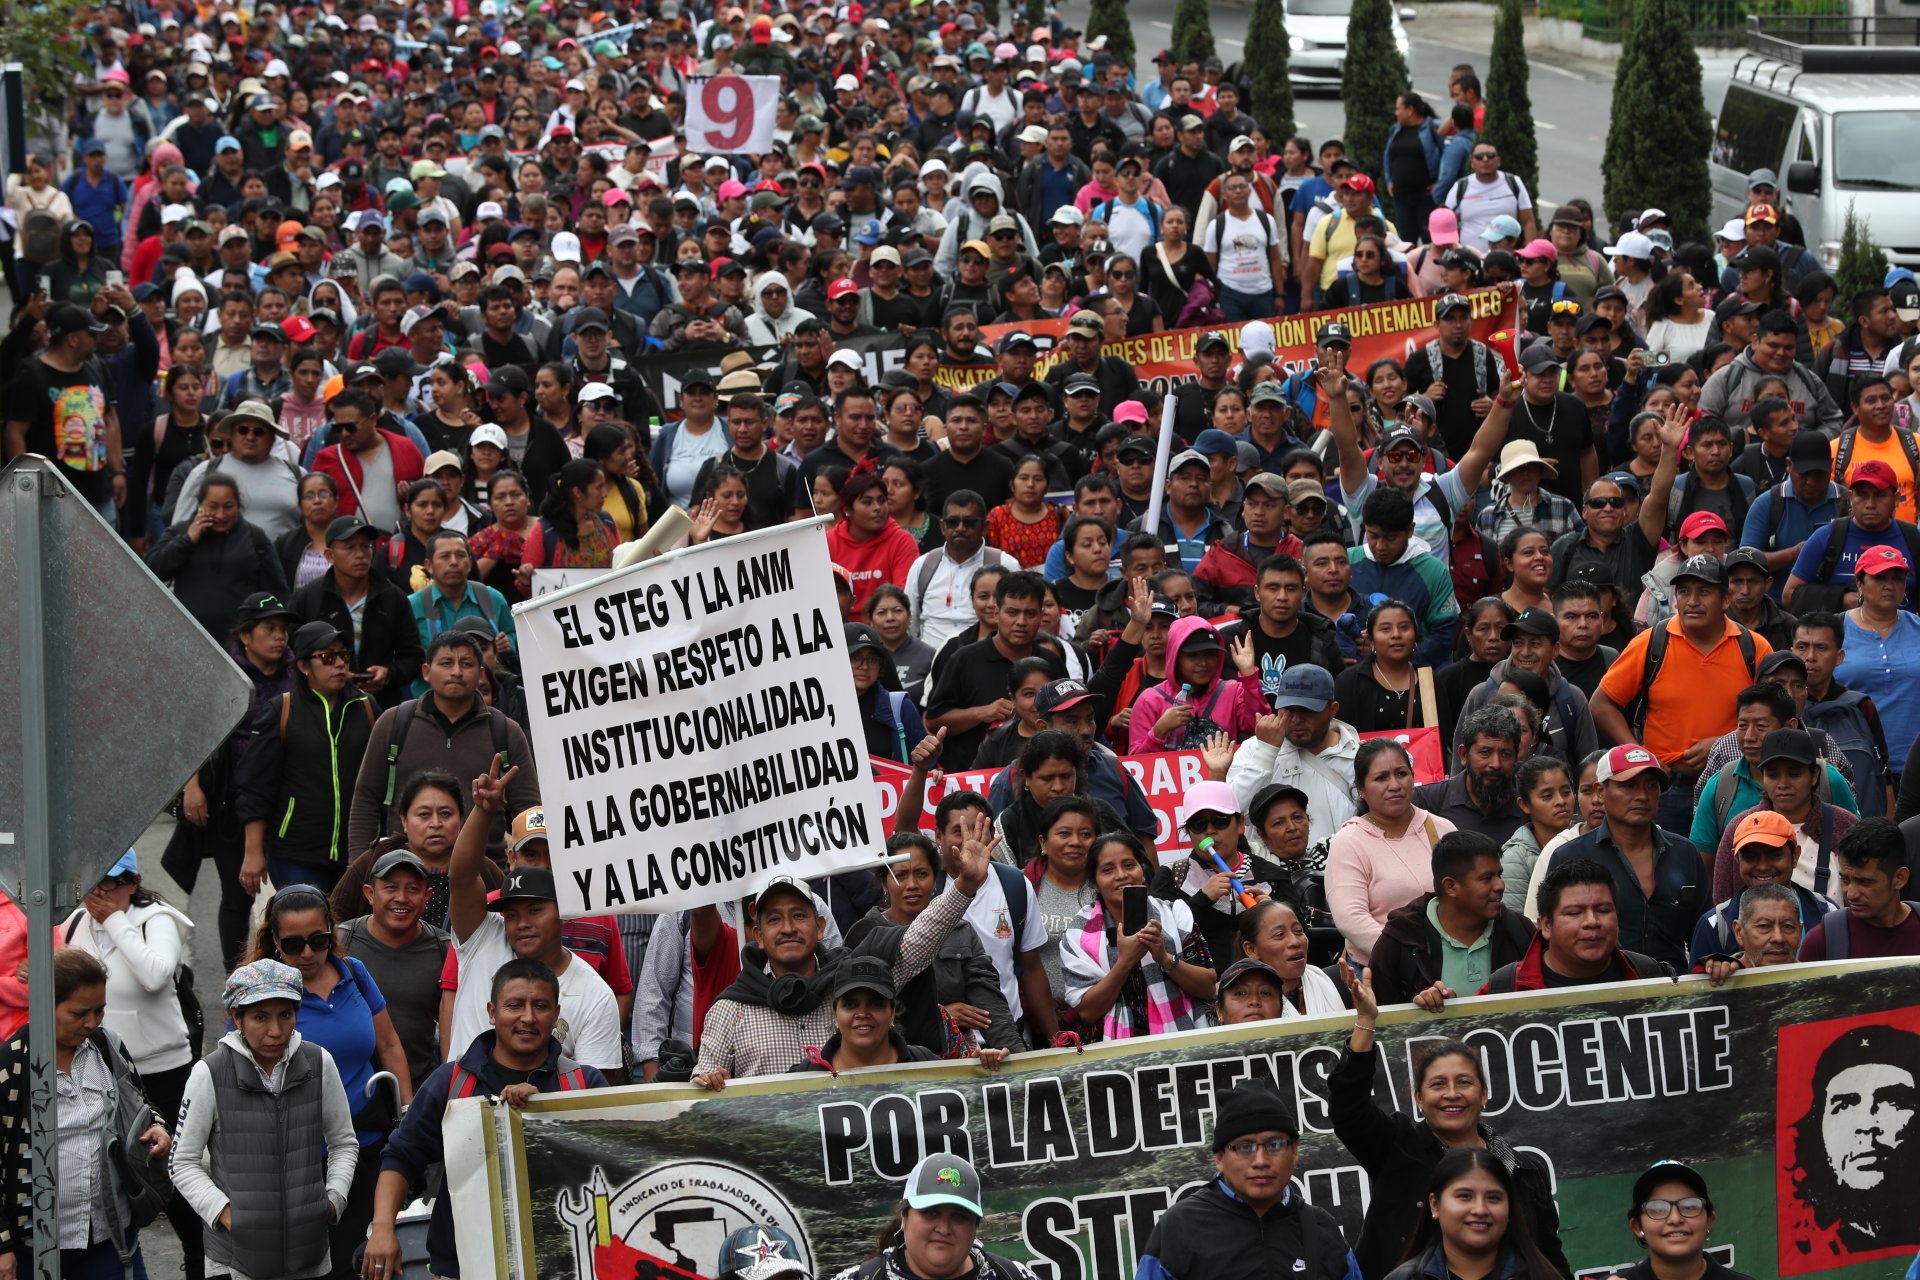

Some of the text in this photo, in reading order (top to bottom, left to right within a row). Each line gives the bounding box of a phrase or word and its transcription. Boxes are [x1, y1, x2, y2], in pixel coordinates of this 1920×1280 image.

[702, 75, 754, 150] 9
[1151, 336, 1176, 364] DE
[1179, 332, 1200, 361] LA
[553, 605, 593, 648] EL
[594, 583, 669, 641] STEG
[671, 576, 692, 620] Y
[697, 566, 733, 615] LA
[736, 548, 794, 603] ANM
[541, 608, 833, 717] EXIGEN RESPETO A LA
[562, 677, 835, 780] INSTITUCIONALIDAD,
[564, 737, 859, 849] A LA GOBERNABILIDAD
[573, 797, 870, 911] Y A LA CONSTITUCIÓN
[819, 1089, 974, 1186] POR
[983, 1077, 1079, 1168] LA
[619, 1183, 668, 1216] SINDICATO
[671, 1179, 685, 1190] DE
[689, 1179, 768, 1218] TRABAJADORES
